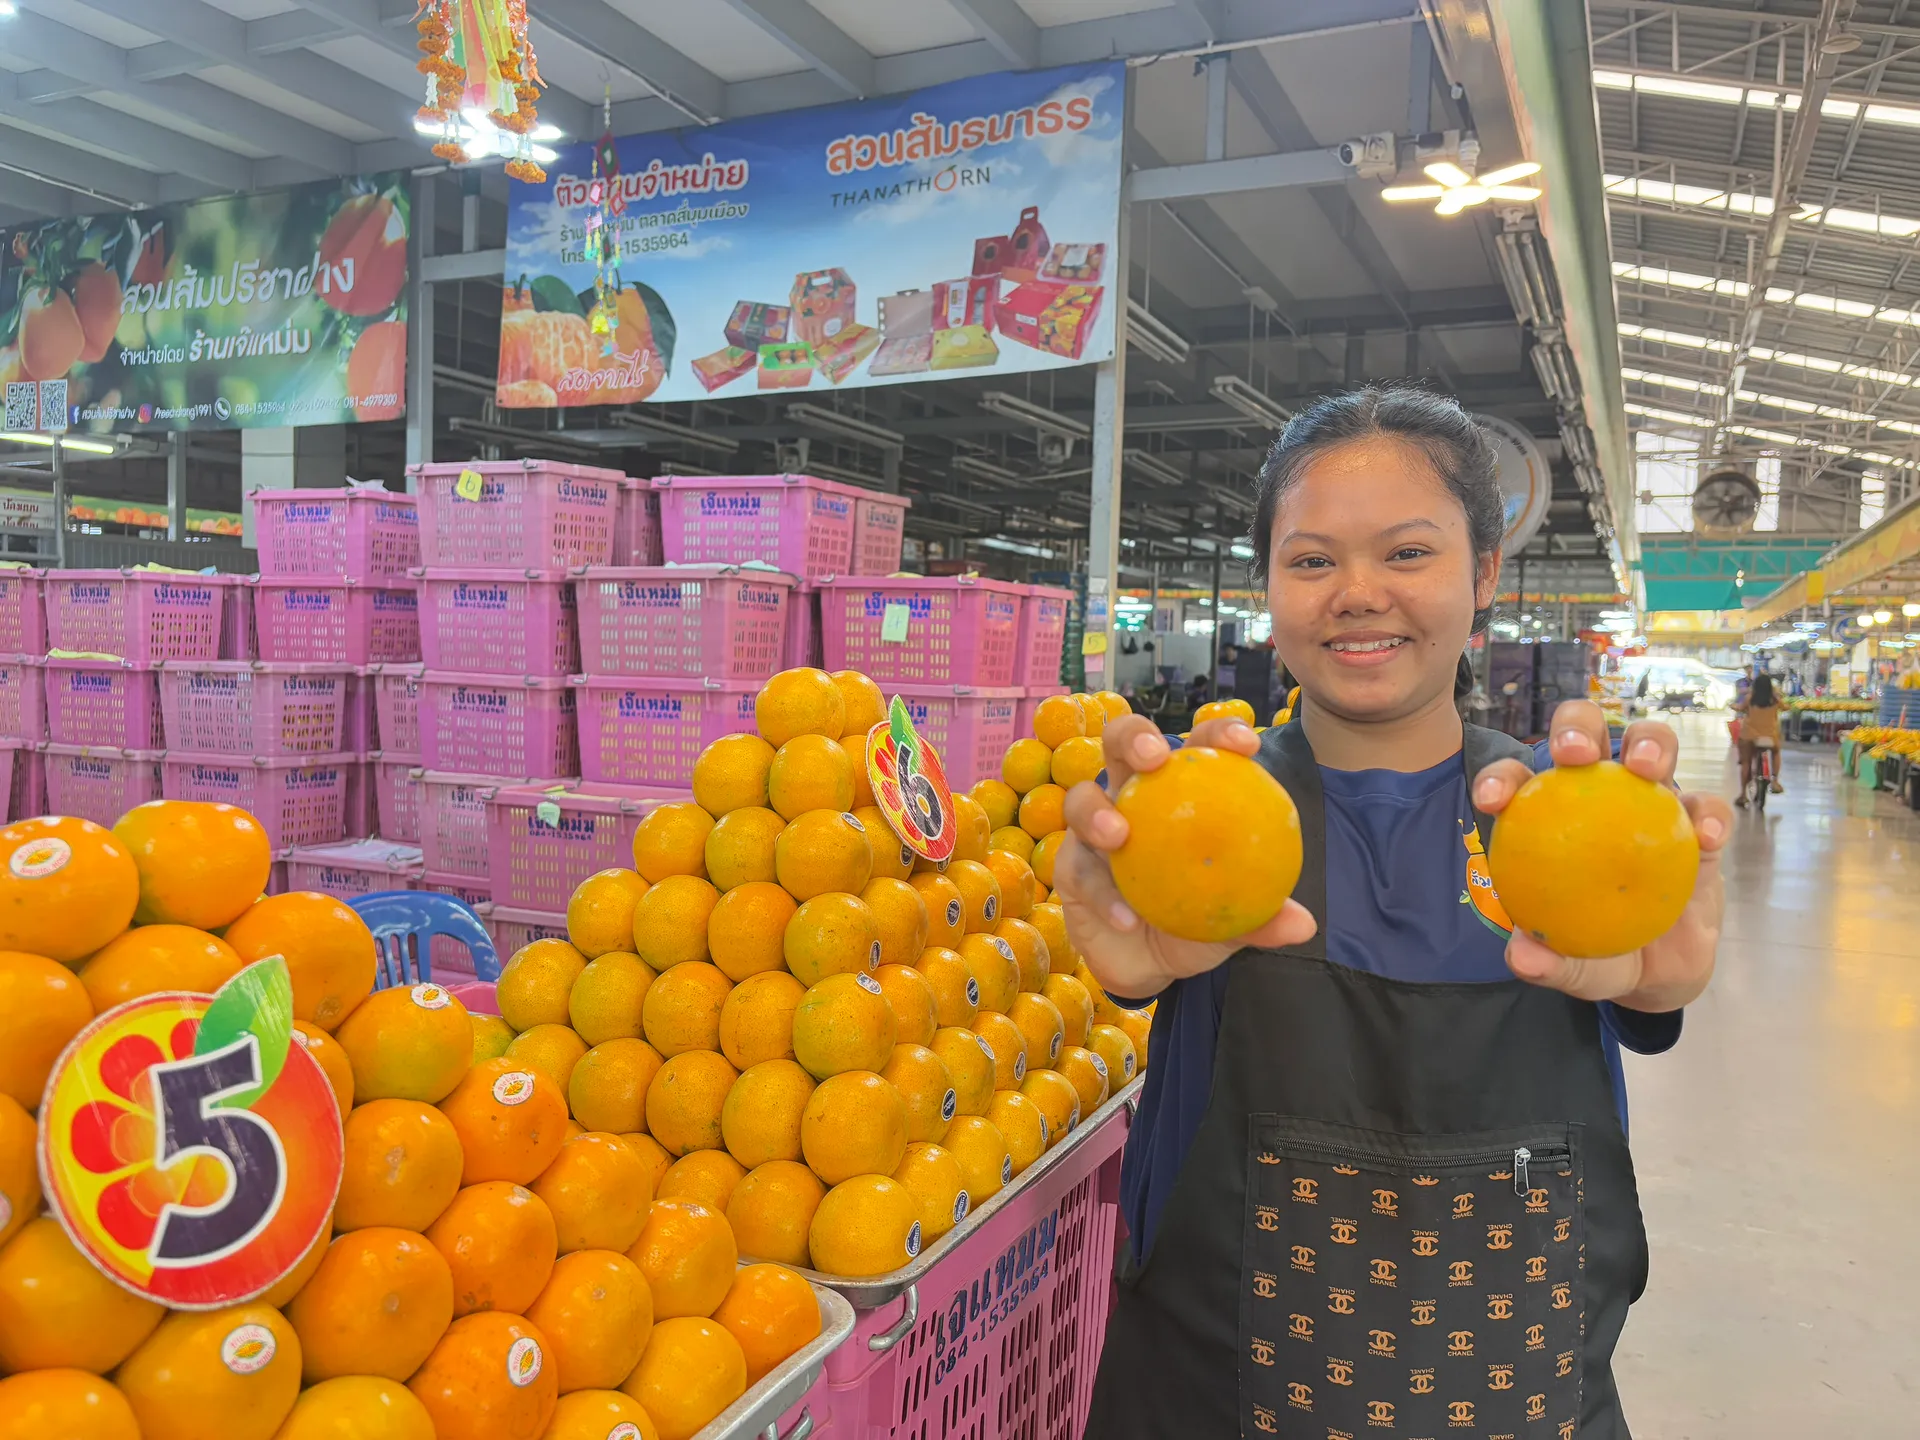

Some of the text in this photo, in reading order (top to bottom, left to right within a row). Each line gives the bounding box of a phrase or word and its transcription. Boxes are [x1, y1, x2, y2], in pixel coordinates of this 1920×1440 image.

[827, 96, 1093, 175] สวนส้มธนาธร
[830, 166, 991, 207] THANATHORN
[639, 199, 748, 229] ตลาดสี่มุมเมือง
[120, 251, 354, 315] สวนส้มปรีชาฝาง
[120, 316, 312, 367] จำหน่ายโดย ร้านเจ๊แหม่ม
[701, 492, 761, 509] เจ๊แหม่ม
[453, 583, 508, 602] เจ๊แหม่ม
[618, 581, 682, 600] เจ๊แหม่ม
[618, 692, 682, 712] เจ๊แหม่ม
[896, 741, 944, 840] 6
[148, 1032, 285, 1268] 5
[1292, 1196, 1318, 1205] CHANEL
[1372, 1208, 1399, 1217] CHANEL
[1369, 1278, 1397, 1287] CHANEL
[935, 1258, 1049, 1386] 084-1535964
[1288, 1332, 1314, 1342] CHANEL
[1368, 1348, 1396, 1359] CHANEL
[1367, 1420, 1395, 1428] CHANEL
